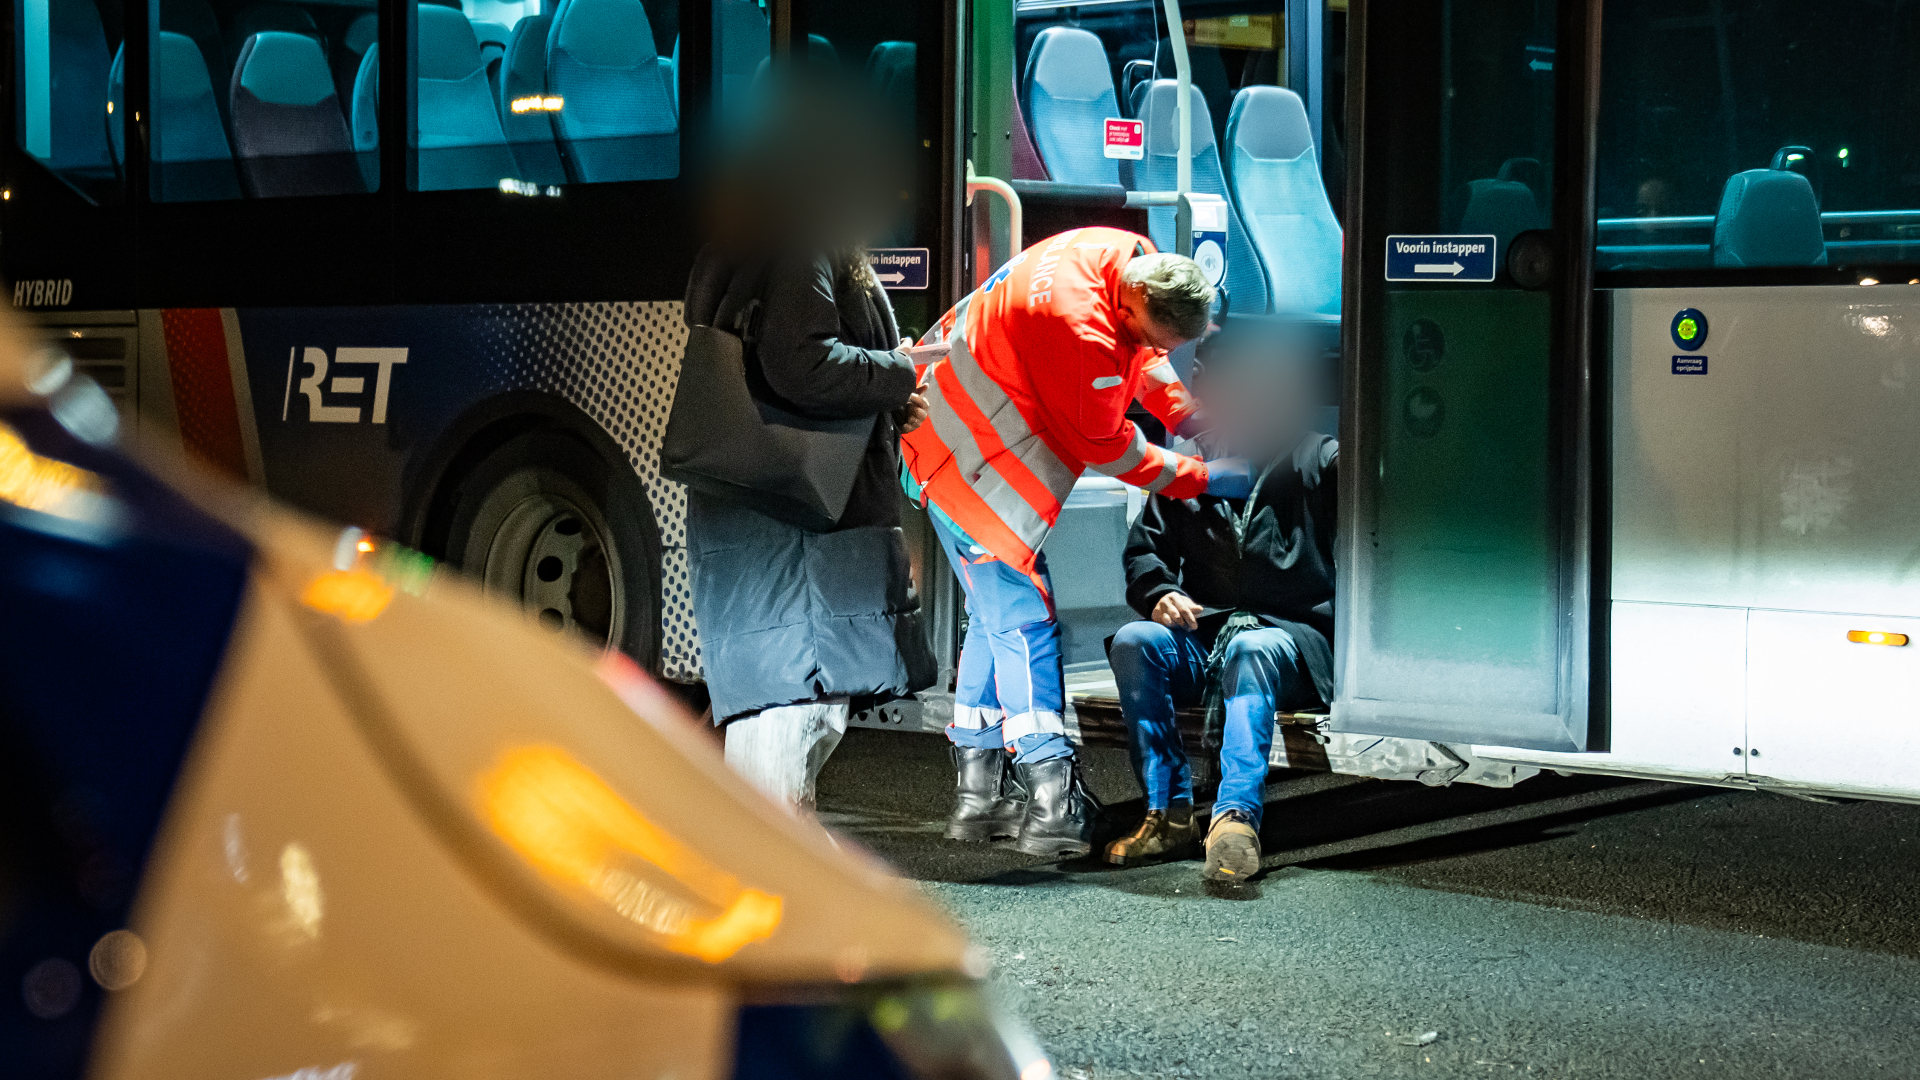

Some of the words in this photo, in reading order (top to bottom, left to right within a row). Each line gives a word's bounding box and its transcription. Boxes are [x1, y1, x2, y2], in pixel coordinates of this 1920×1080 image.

[1396, 241, 1430, 253] Voorin
[1432, 241, 1485, 257] instappen
[880, 254, 921, 267] instappen
[13, 279, 73, 306] HYBRID
[283, 346, 409, 424] RET
